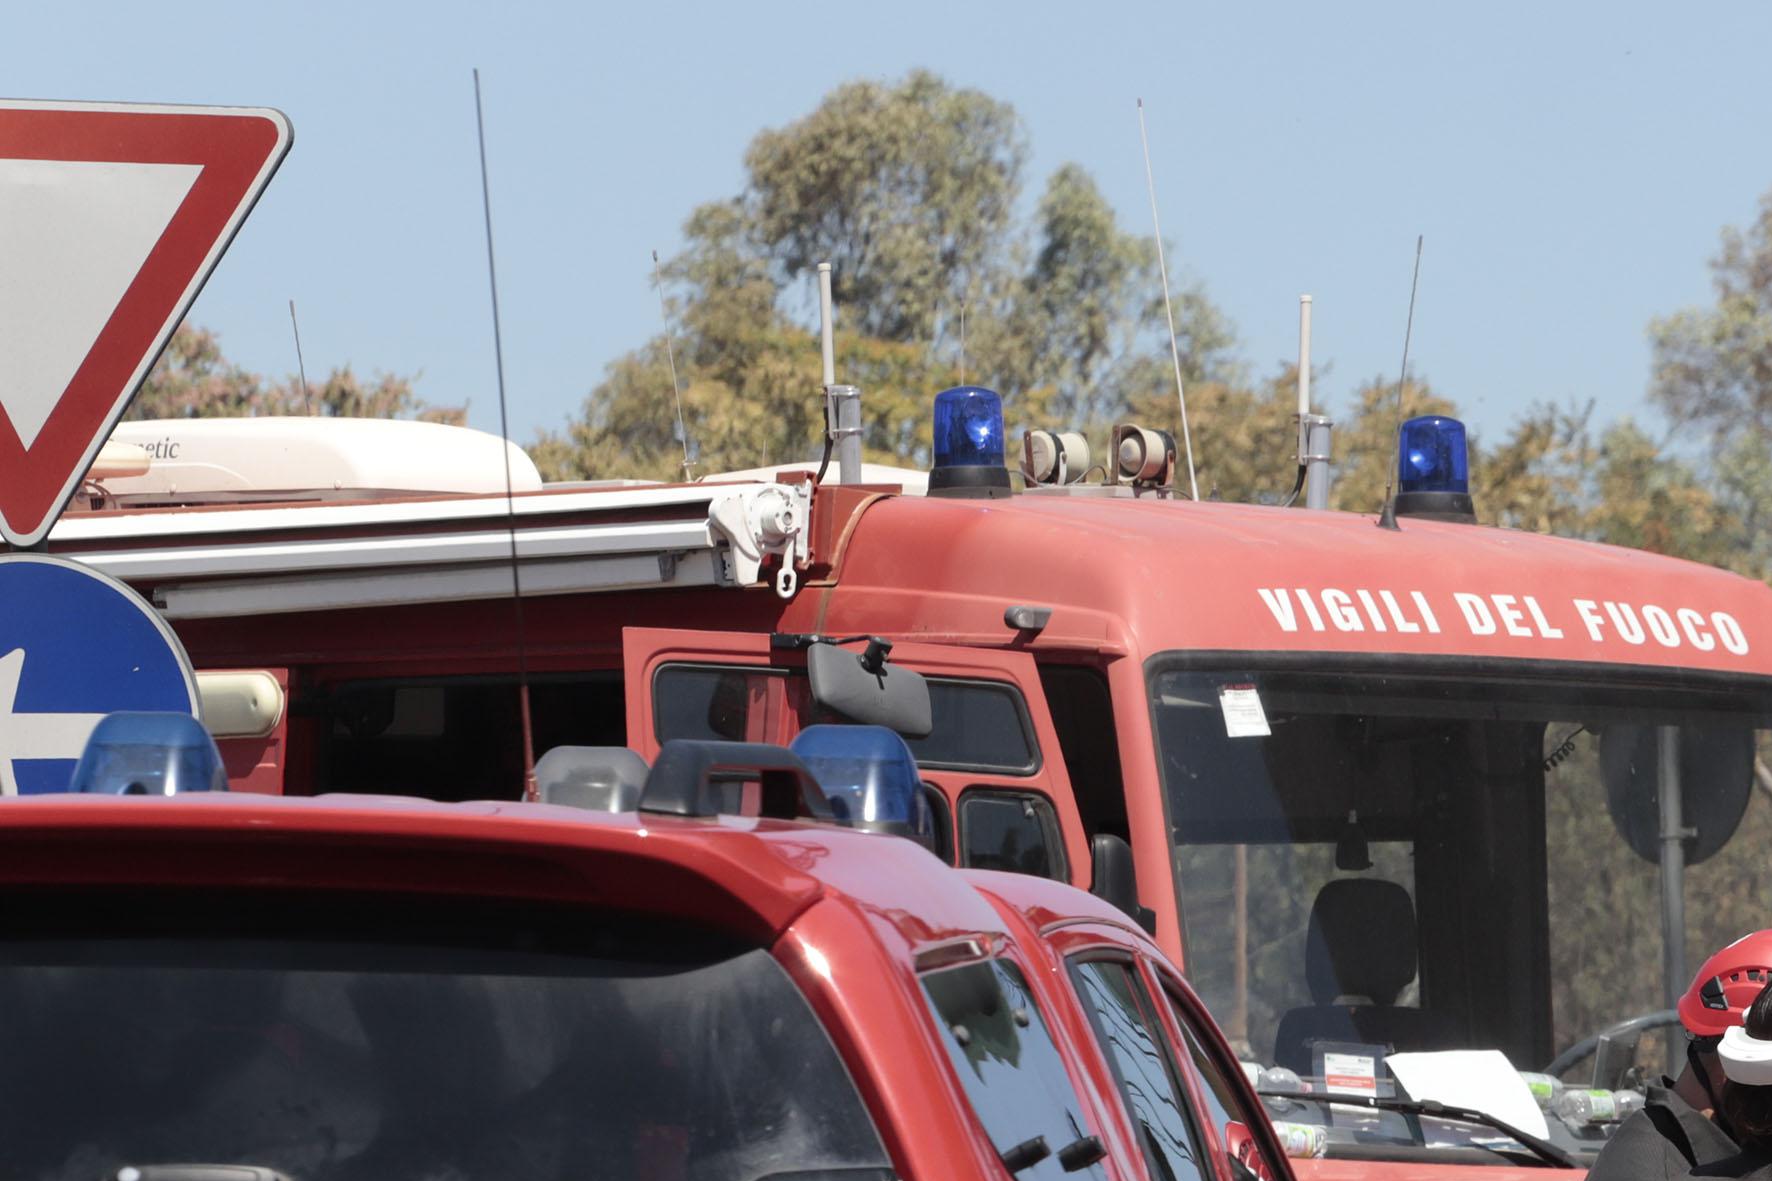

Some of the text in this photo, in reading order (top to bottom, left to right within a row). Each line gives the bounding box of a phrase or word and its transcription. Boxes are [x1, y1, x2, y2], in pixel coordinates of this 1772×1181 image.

[139, 436, 181, 459] etic
[1257, 587, 1750, 656] VIGILI DEL FUOCO
